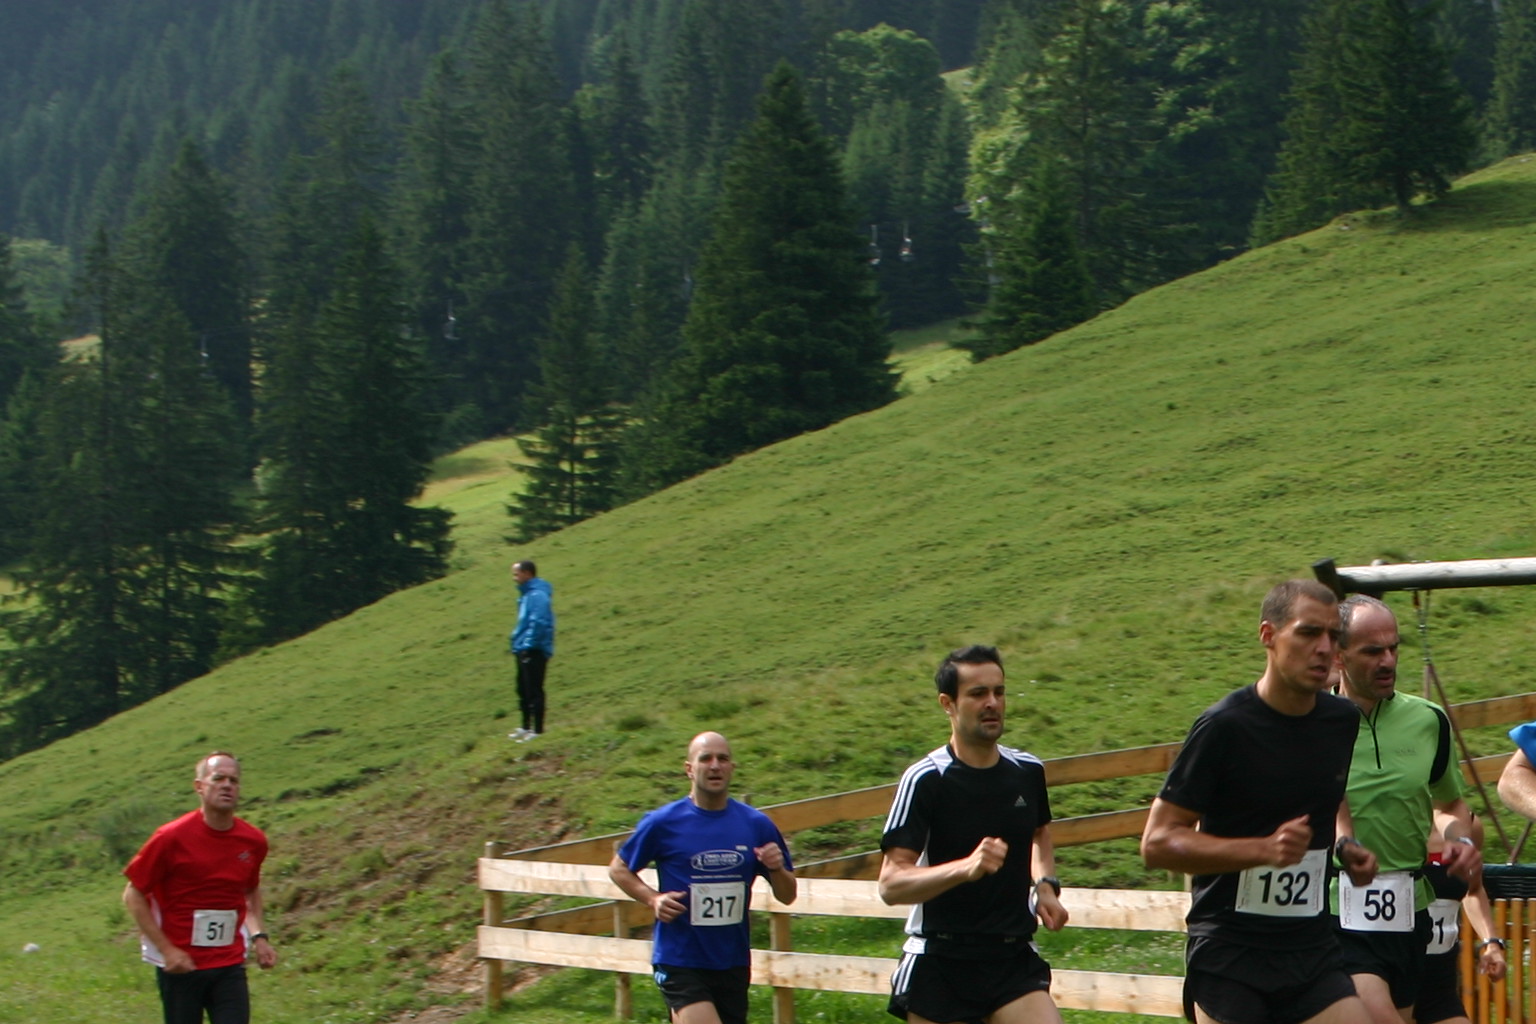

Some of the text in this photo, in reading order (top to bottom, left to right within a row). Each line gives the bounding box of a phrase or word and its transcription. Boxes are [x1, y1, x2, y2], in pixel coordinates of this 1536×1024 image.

[1259, 871, 1310, 906] 132
[702, 896, 737, 918] 217
[1364, 890, 1396, 921] 58
[206, 922, 225, 941] 51
[1435, 917, 1444, 944] 1
